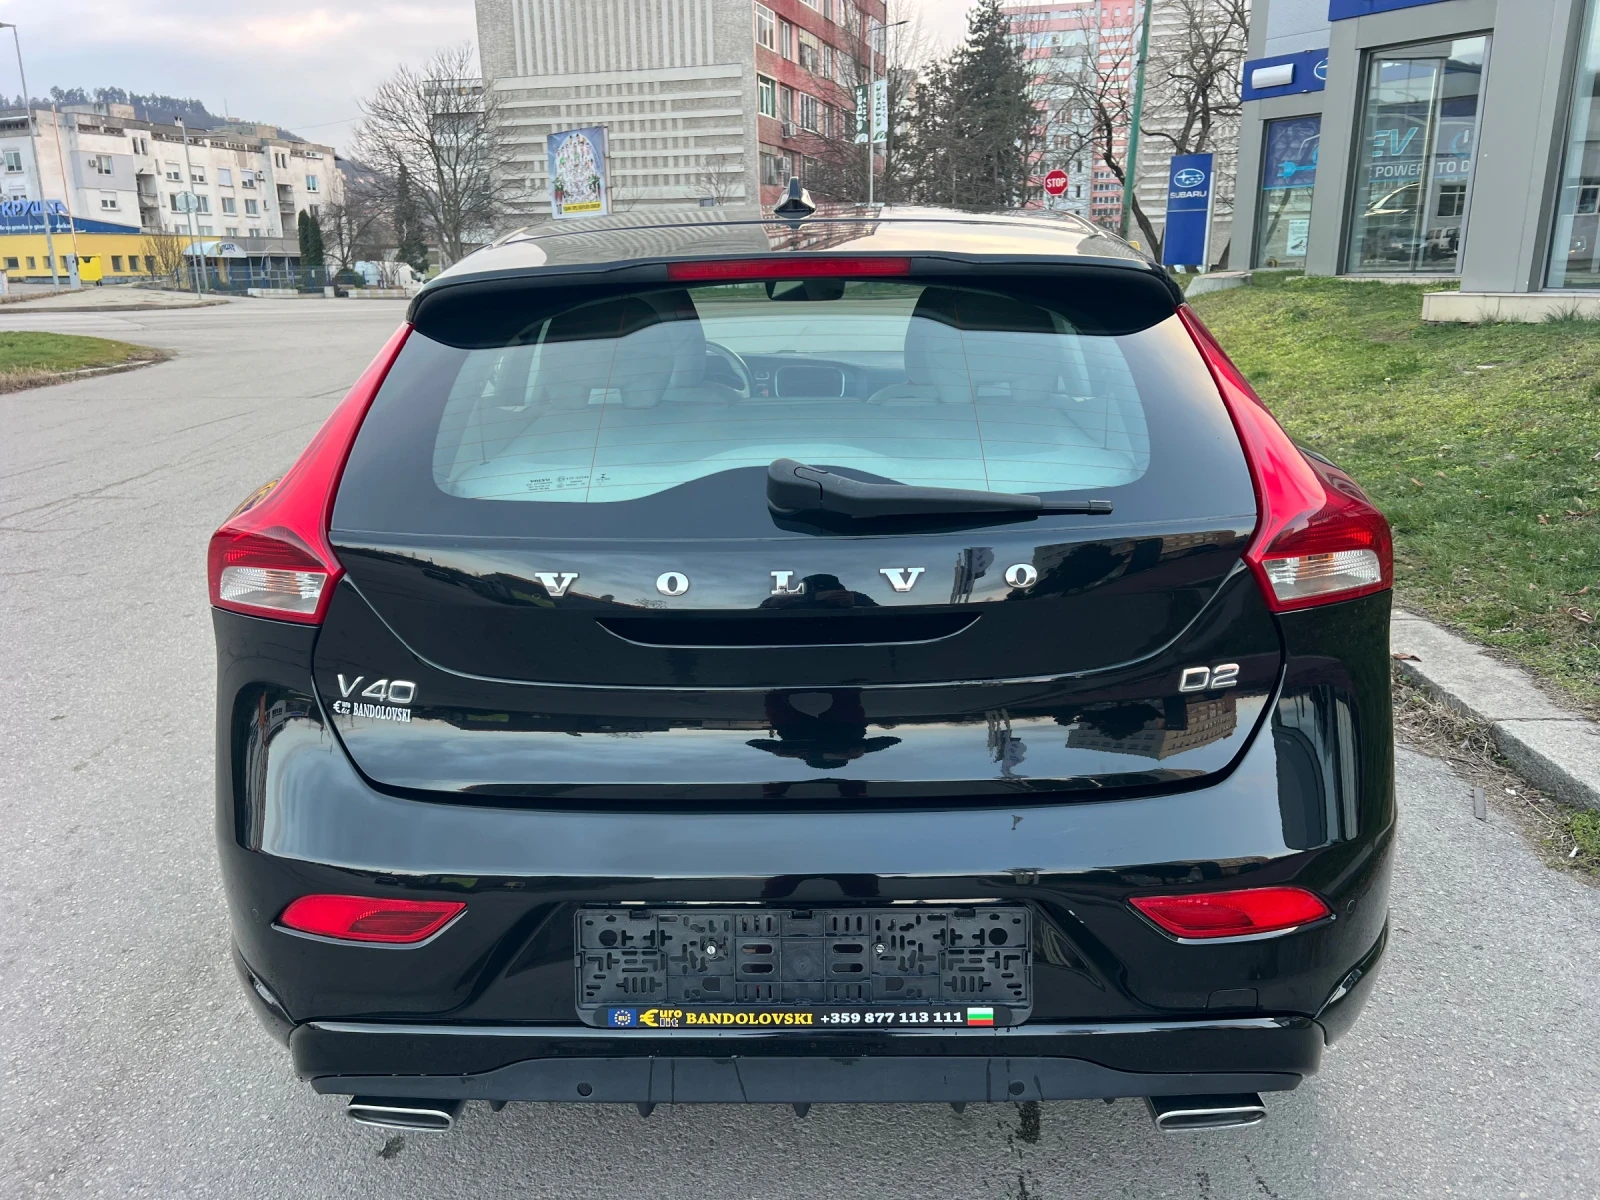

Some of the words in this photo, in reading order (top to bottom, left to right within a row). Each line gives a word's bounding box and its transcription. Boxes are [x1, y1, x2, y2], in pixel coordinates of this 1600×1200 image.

[1438, 161, 1456, 173] TO
[1046, 177, 1066, 188] STOP
[1169, 190, 1207, 199] SUBARU
[535, 563, 1038, 597] VOLVO
[1179, 663, 1240, 693] D2
[337, 673, 417, 704] V40
[352, 702, 412, 723] BANDOLOVSKI
[686, 1012, 813, 1025] BANDOLOVSKI
[820, 1012, 861, 1024] +359
[864, 1012, 895, 1024] 877
[899, 1011, 929, 1024] 113
[932, 1011, 964, 1023] 111
